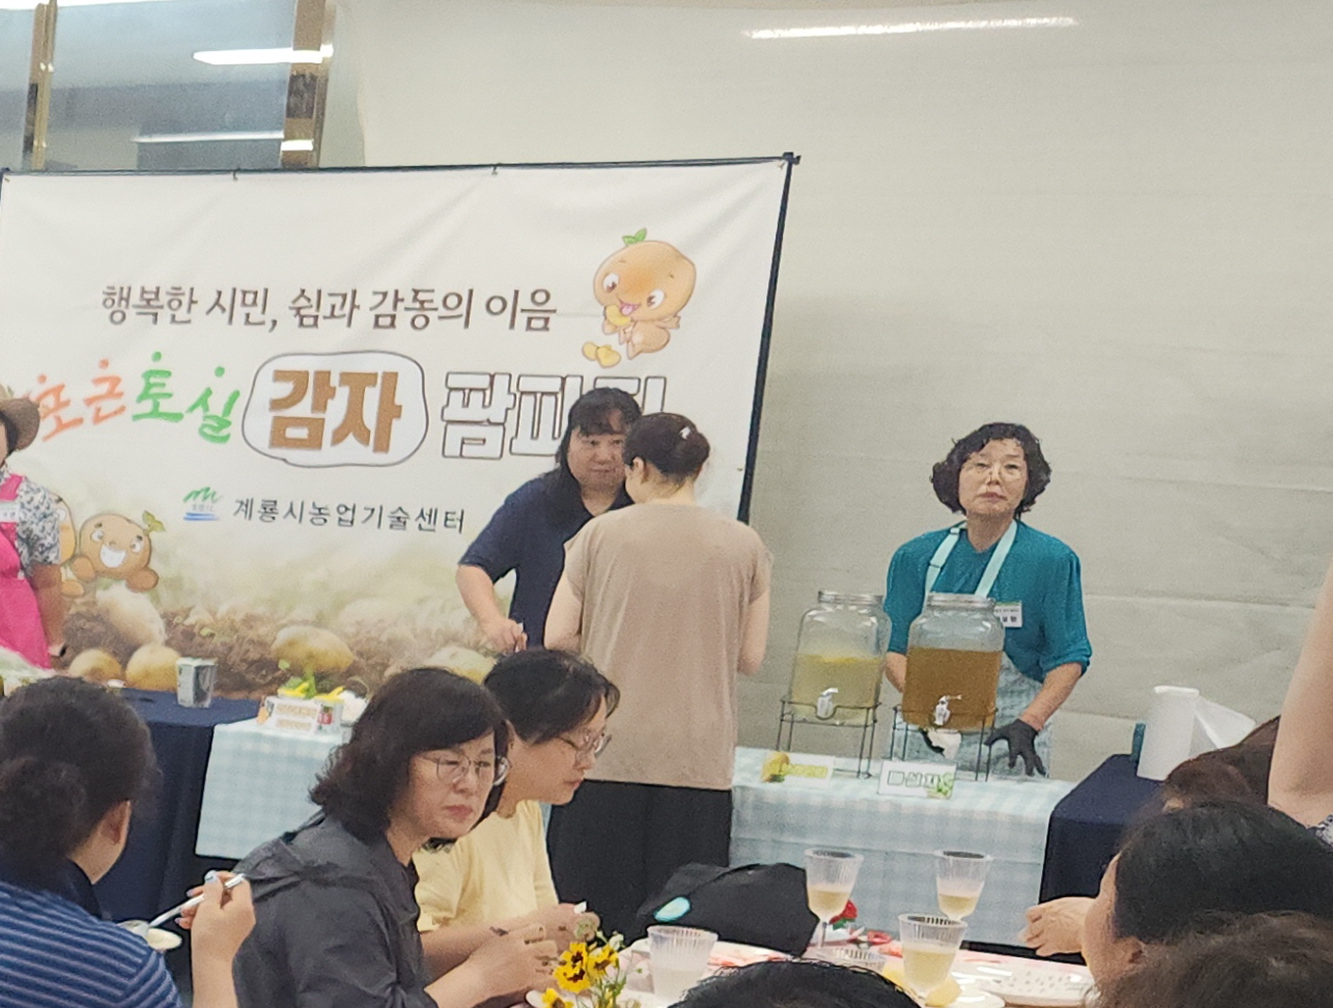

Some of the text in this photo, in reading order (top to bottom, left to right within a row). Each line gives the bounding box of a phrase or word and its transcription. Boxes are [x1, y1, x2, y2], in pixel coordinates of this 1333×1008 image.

[102, 285, 558, 333] 행복한 시민, 쉼과 감동의 이음
[268, 369, 403, 454] 감자
[232, 496, 466, 534] 계룡시농업기술센터
